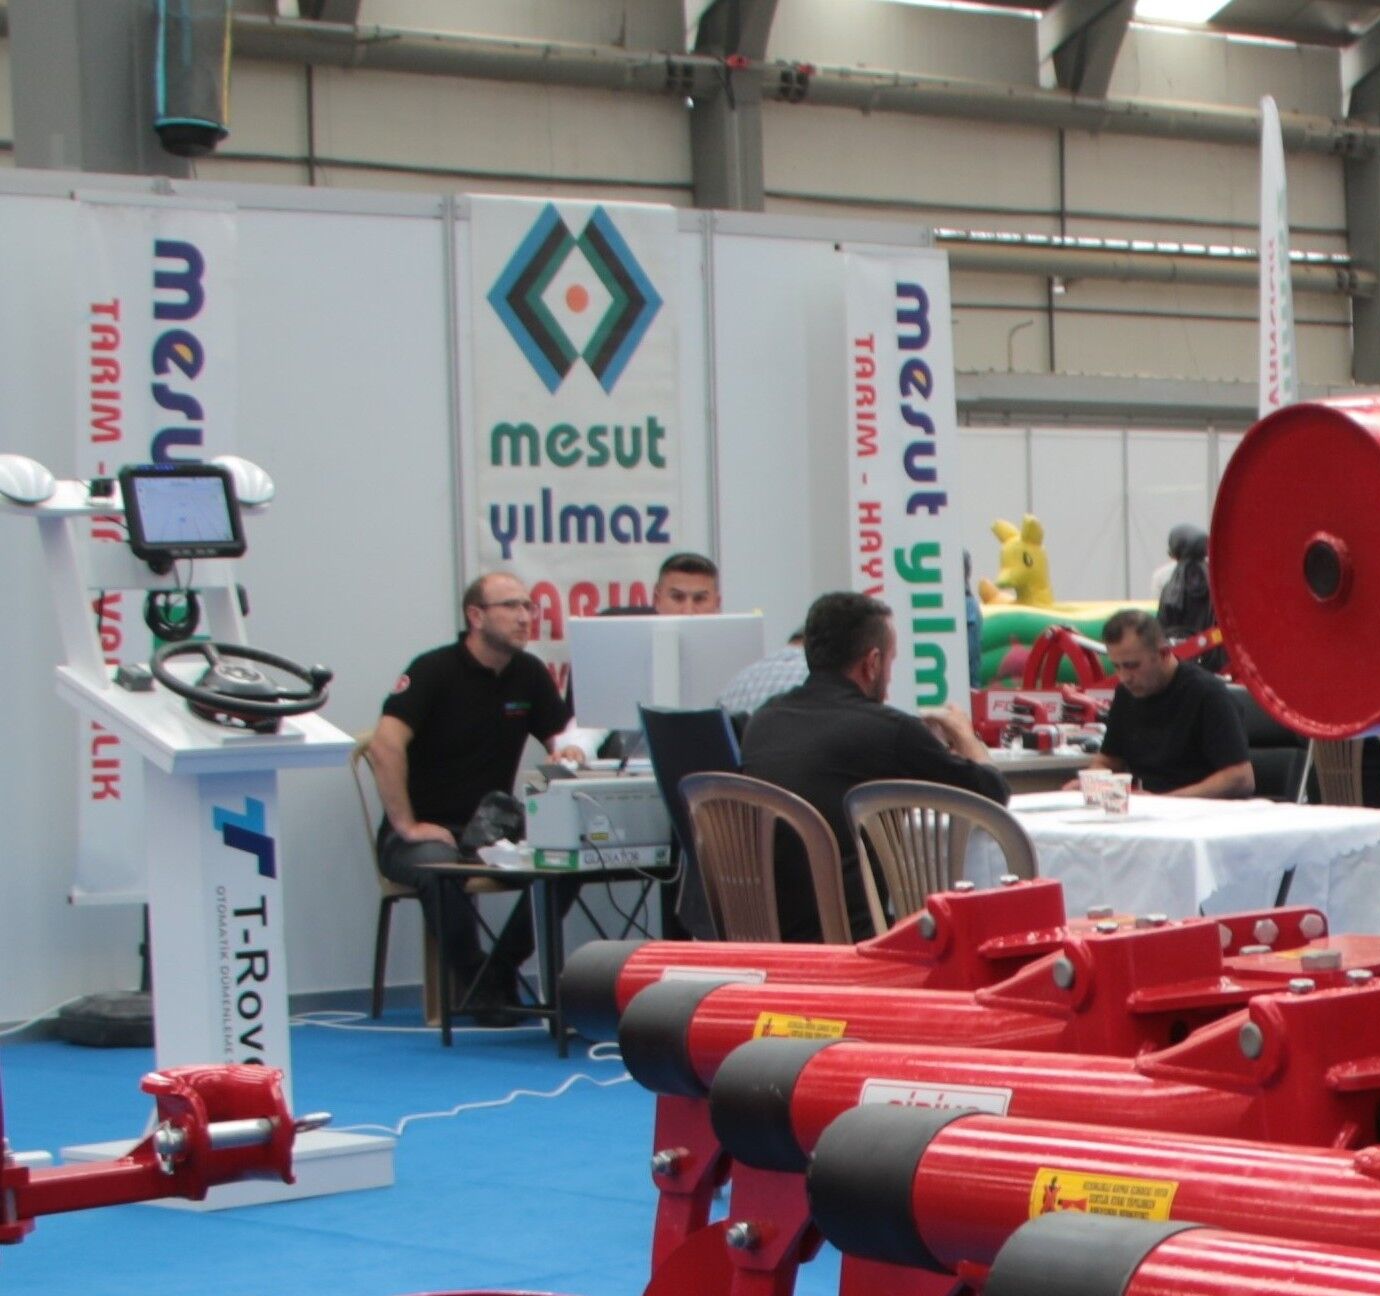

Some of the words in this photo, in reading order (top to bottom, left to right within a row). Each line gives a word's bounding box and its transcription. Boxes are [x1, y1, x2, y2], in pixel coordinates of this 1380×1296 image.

[91, 298, 122, 443] TARIM
[151, 239, 205, 466] mesu
[855, 334, 878, 458] TARIM
[897, 281, 947, 516] mesut
[490, 416, 666, 469] mesut
[490, 487, 670, 560] yılmaz
[894, 541, 957, 707] yılm
